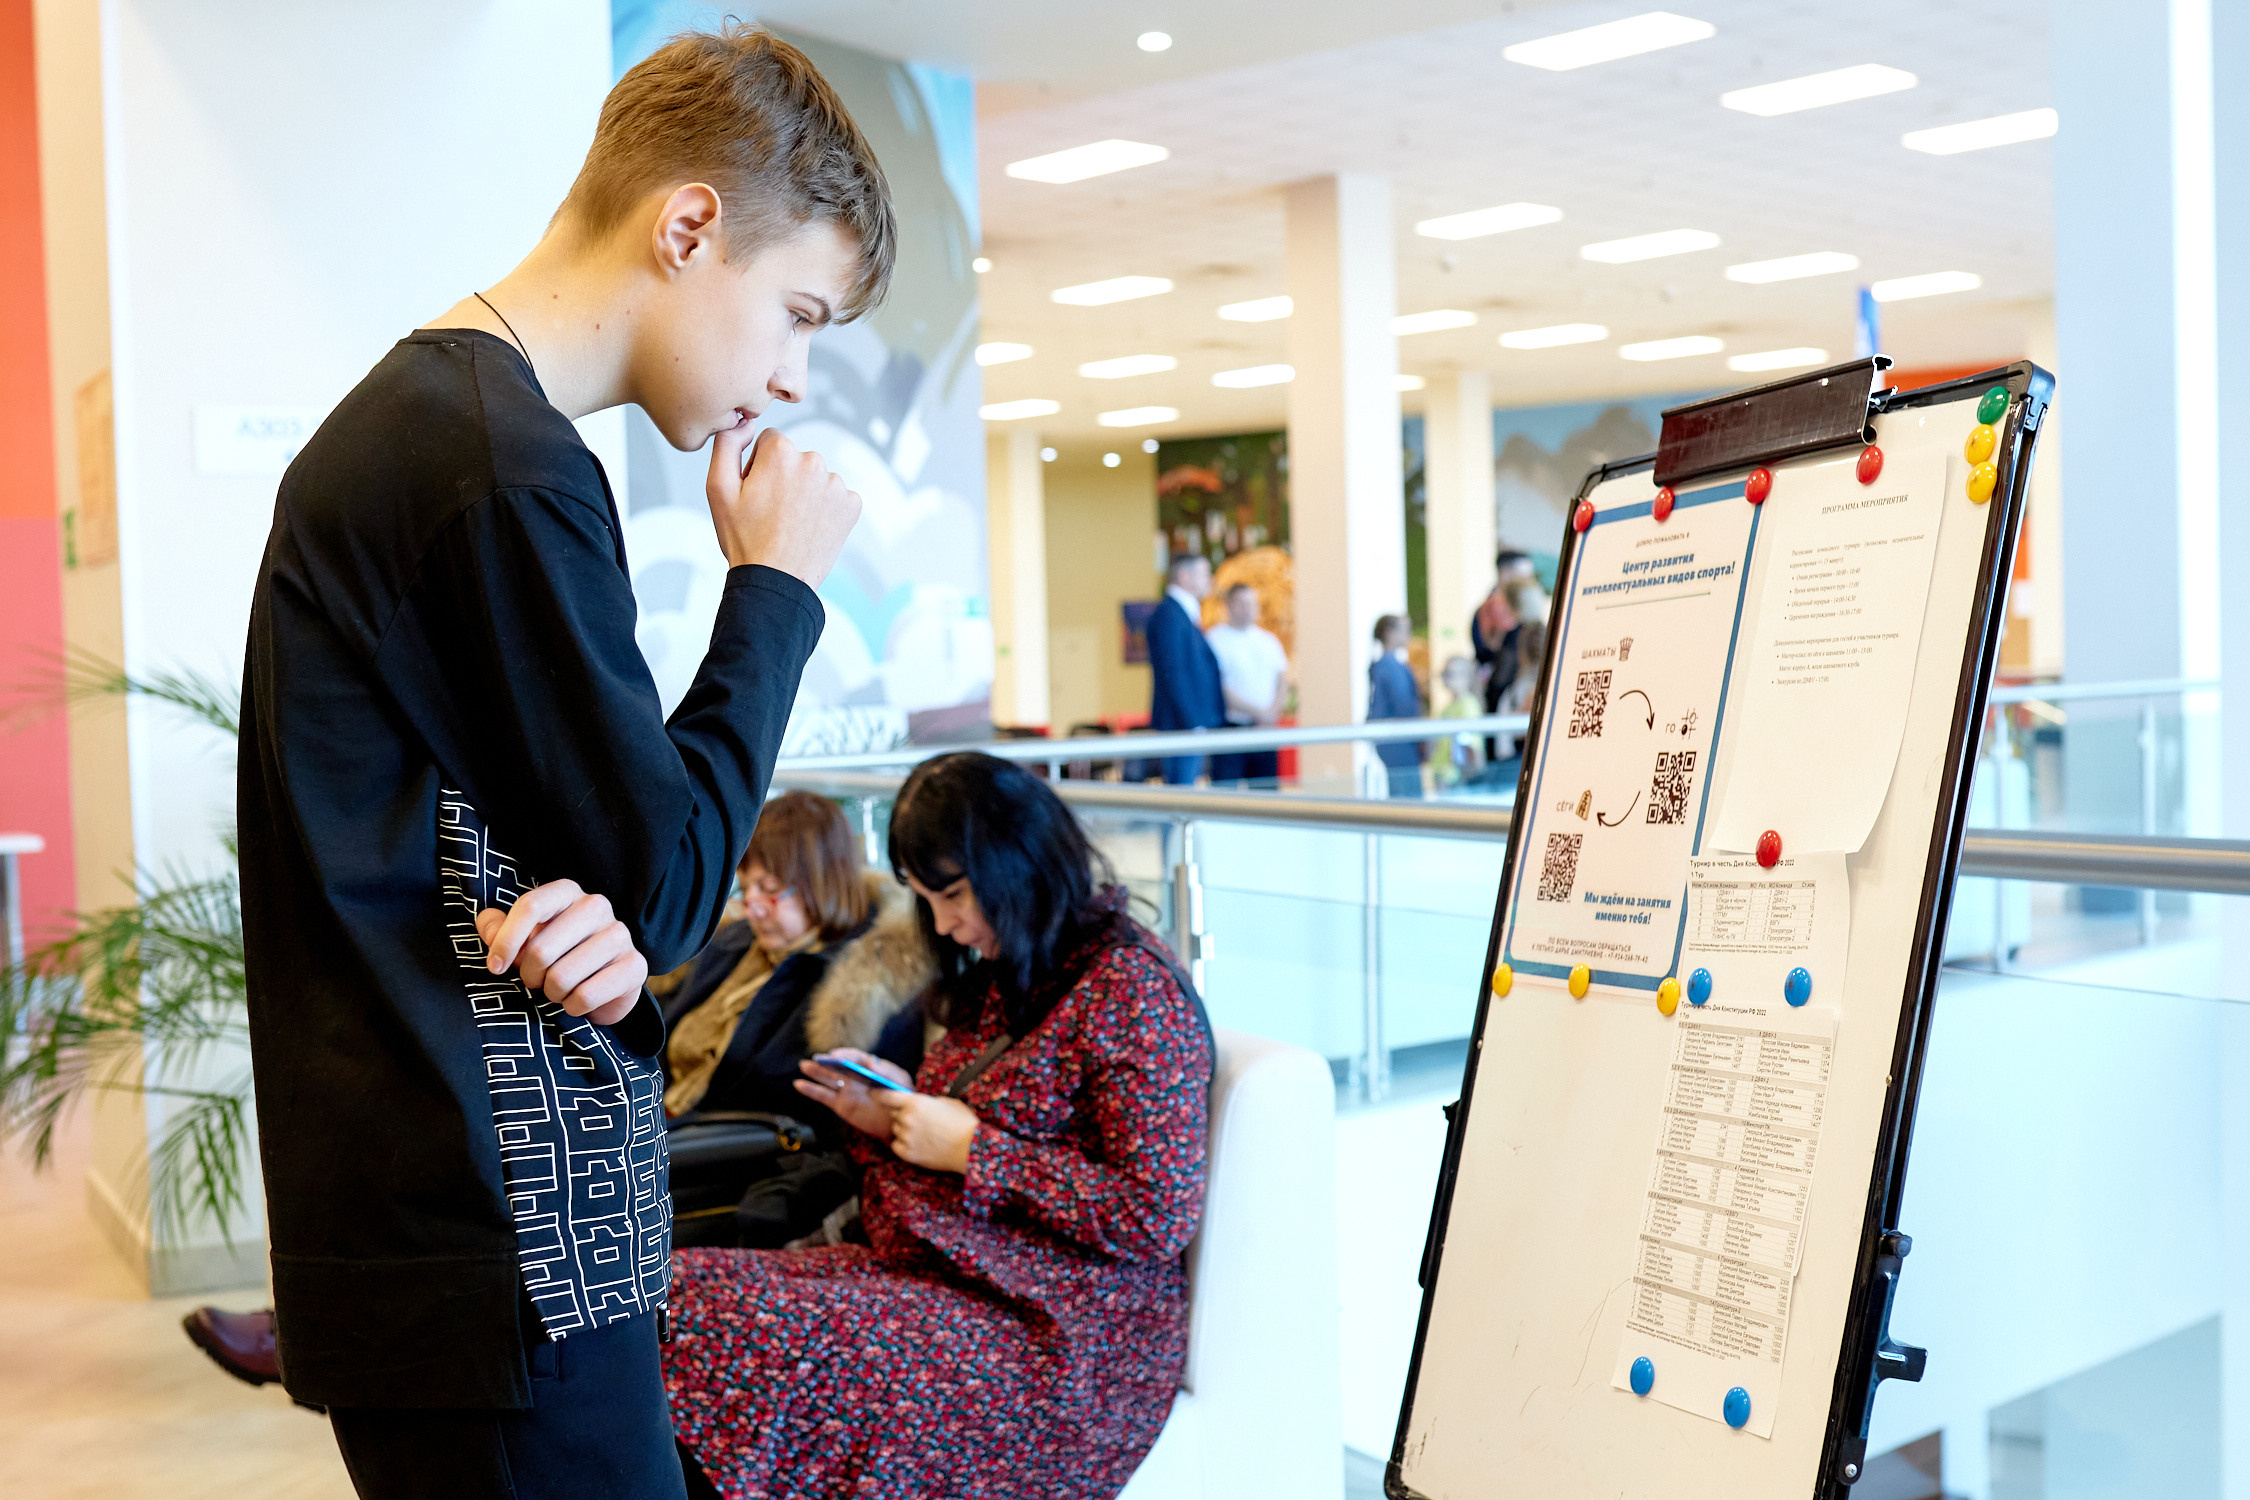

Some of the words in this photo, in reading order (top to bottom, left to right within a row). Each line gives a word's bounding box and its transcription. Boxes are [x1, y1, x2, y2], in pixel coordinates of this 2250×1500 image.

[1822, 502, 1859, 514] ПРОГРАММА
[1653, 533, 1685, 544] ПОЖАЛОВАТЬ
[1622, 558, 1649, 573] Центр
[1651, 554, 1694, 572] развития
[1582, 576, 1665, 596] интеллектуальных
[1667, 570, 1695, 583] видов
[1697, 561, 1736, 581] спорта!
[1581, 647, 1616, 659] ШАХМАТЫ
[1584, 892, 1599, 904] Мы
[1600, 892, 1623, 907] ждём
[1625, 897, 1635, 906] на
[1636, 898, 1671, 909] занятия
[1595, 911, 1627, 923] именно
[1629, 912, 1651, 925] тебя!
